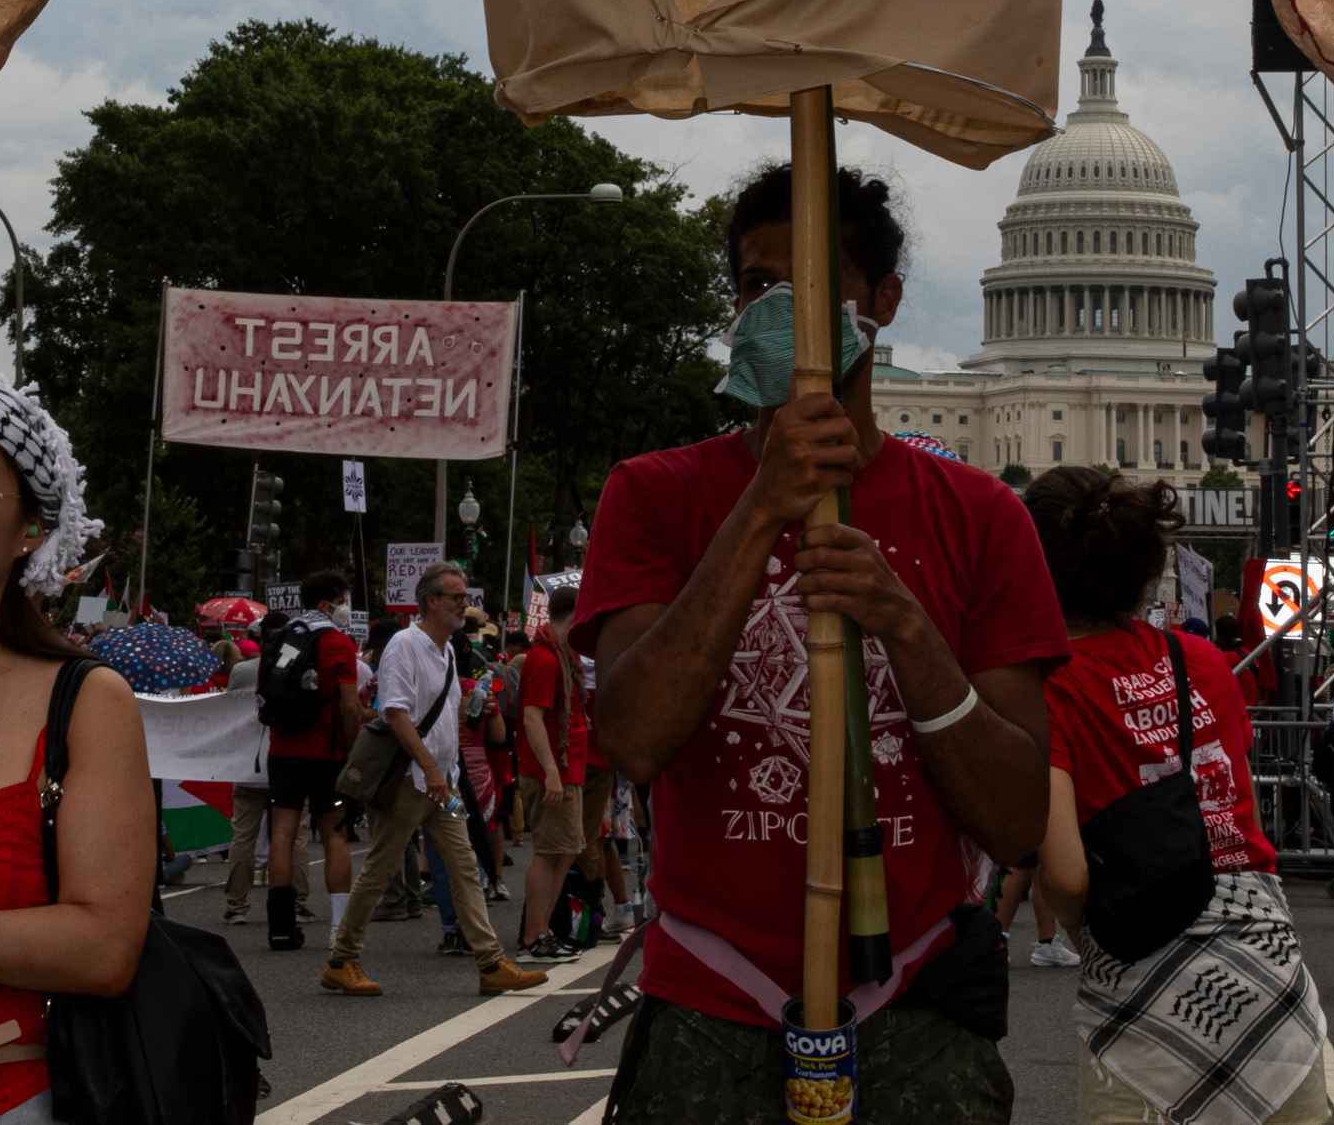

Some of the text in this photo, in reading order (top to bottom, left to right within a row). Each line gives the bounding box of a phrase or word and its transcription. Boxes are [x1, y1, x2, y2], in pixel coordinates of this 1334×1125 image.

[1175, 489, 1254, 525] TINE!
[388, 564, 416, 576] RED
[547, 572, 582, 585] STO
[269, 595, 301, 610] GAZA
[388, 589, 408, 603] WE
[1123, 689, 1209, 732] ABOLIH
[1211, 850, 1249, 868] NGELES
[786, 1031, 847, 1056] GOYA
